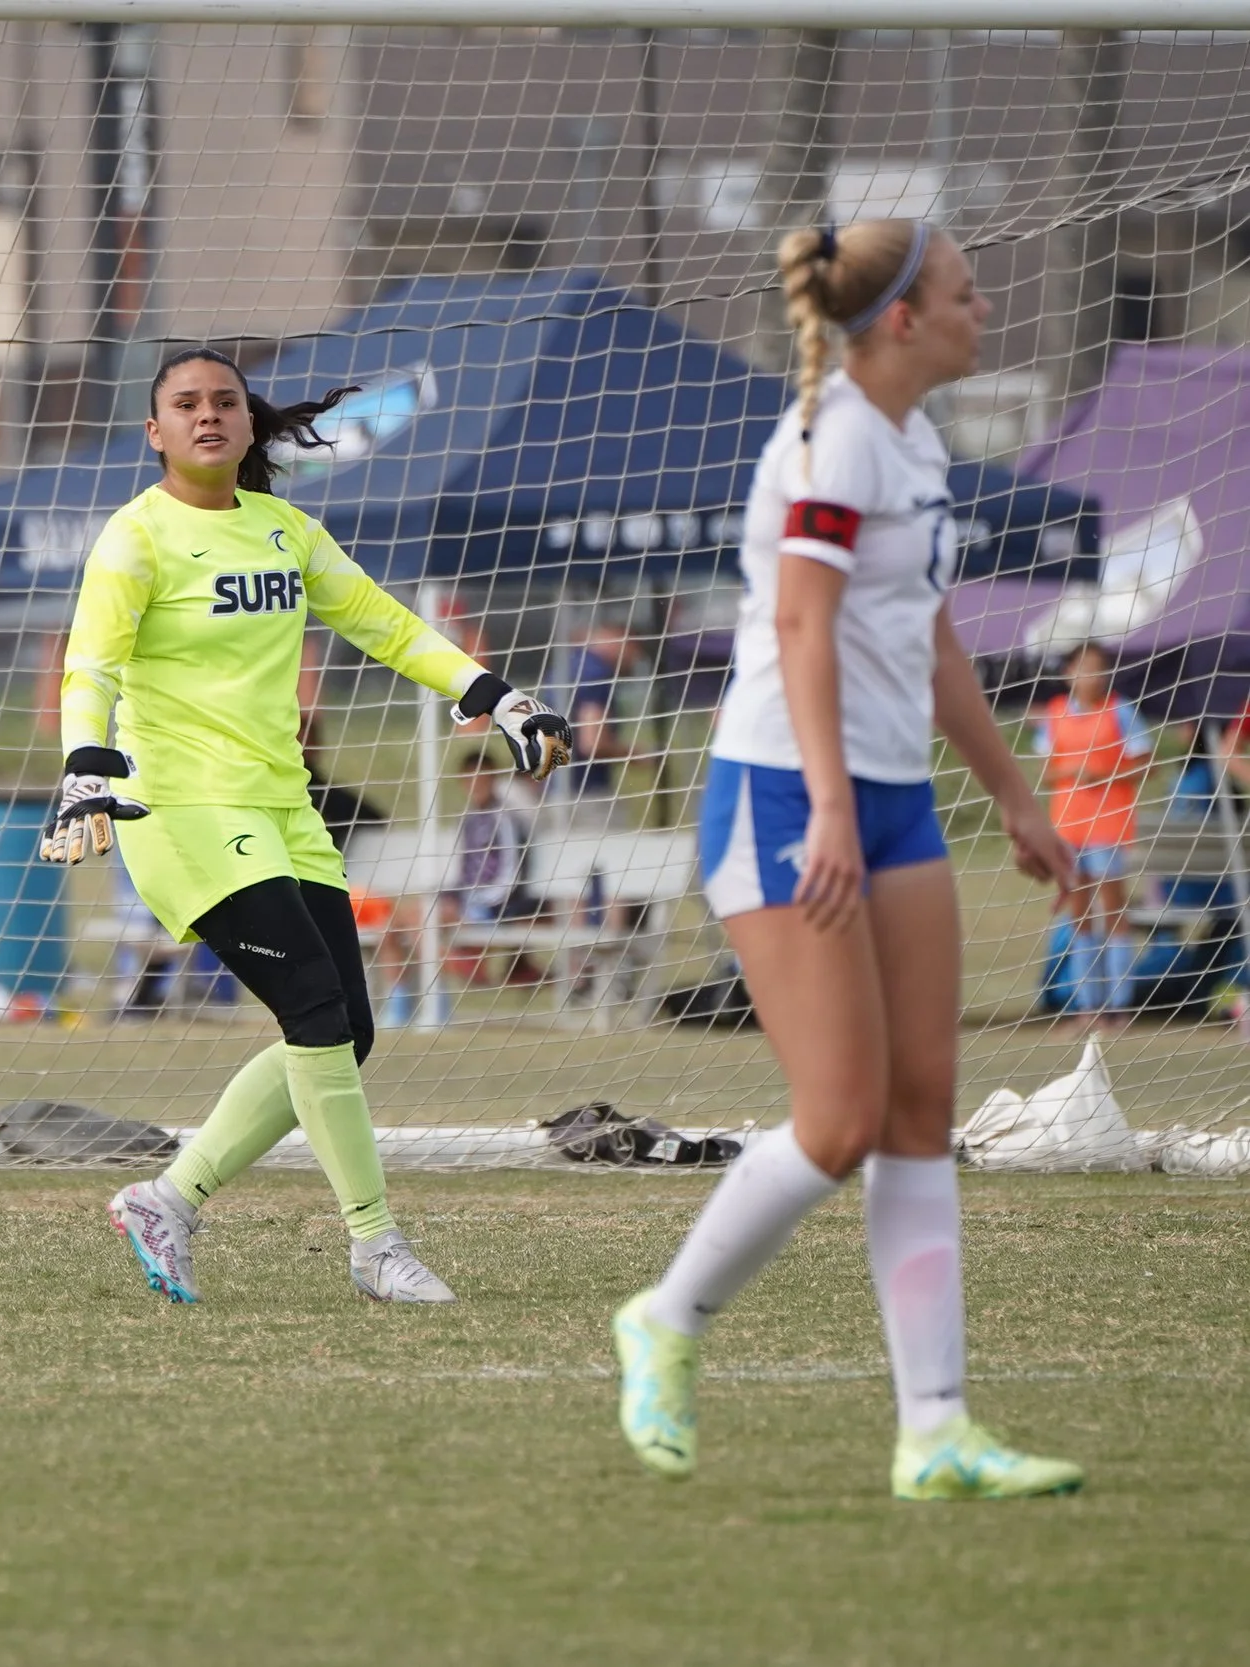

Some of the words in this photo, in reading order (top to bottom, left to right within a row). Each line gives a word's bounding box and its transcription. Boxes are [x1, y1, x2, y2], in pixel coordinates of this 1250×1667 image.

[802, 503, 845, 543] C
[210, 569, 305, 616] SURF
[238, 942, 287, 958] STORELLI
